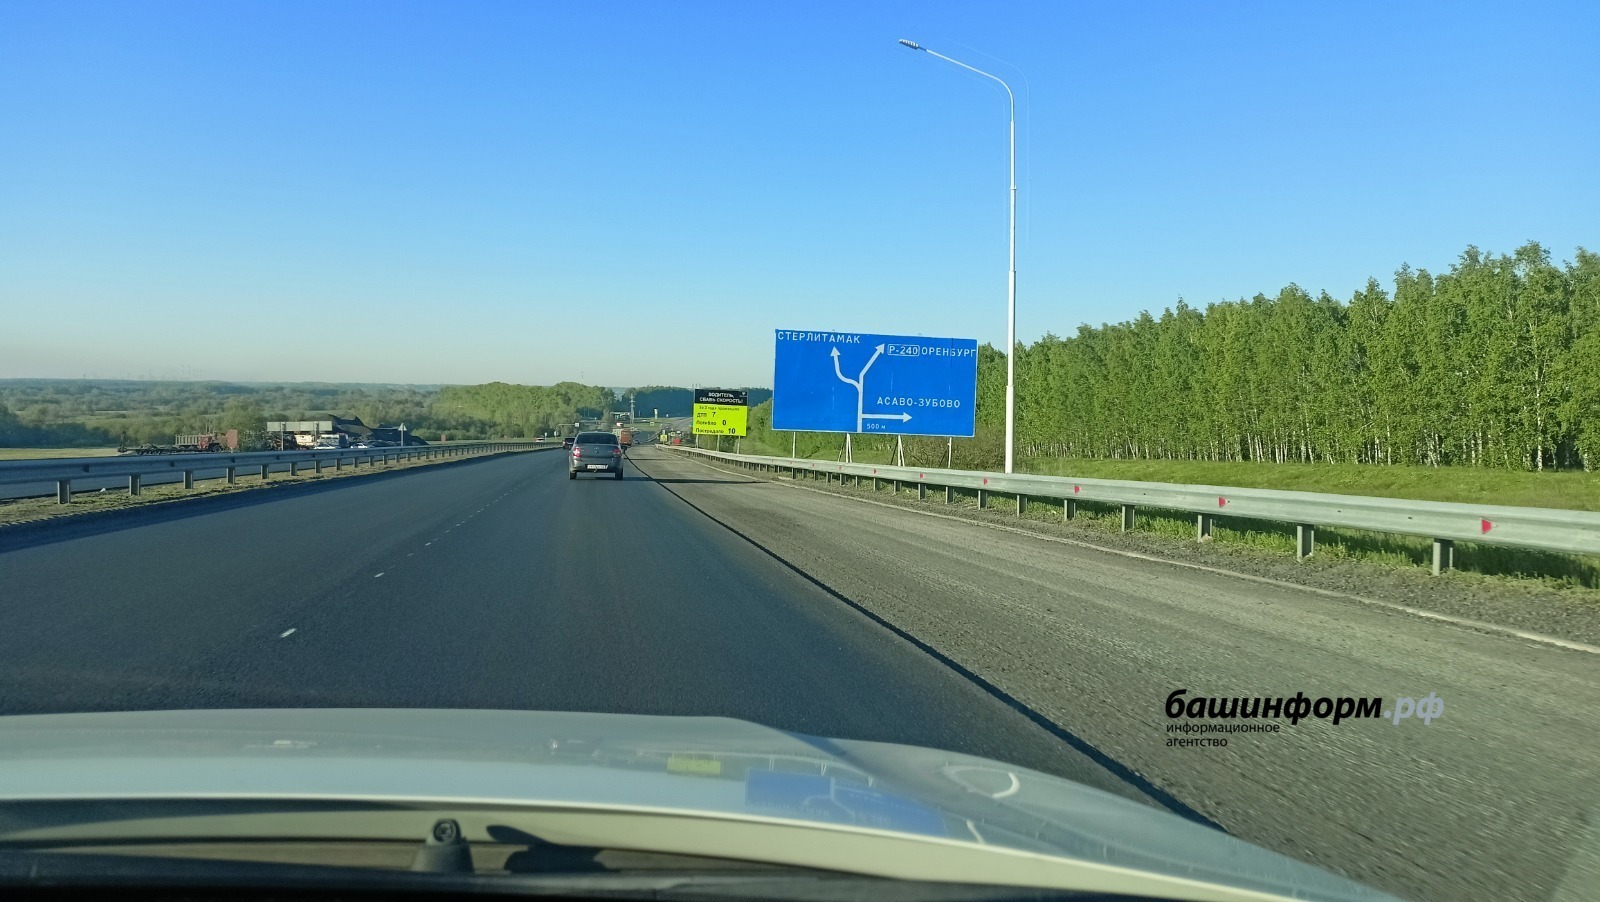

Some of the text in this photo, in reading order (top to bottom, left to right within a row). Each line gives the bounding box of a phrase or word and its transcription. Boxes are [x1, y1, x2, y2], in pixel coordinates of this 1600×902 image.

[777, 331, 860, 343] СТЕРЛИТАМАК
[889, 345, 976, 357] Р-240 ОРЕНБУРГ
[876, 396, 960, 408] АСАВО-ЗУБОВО
